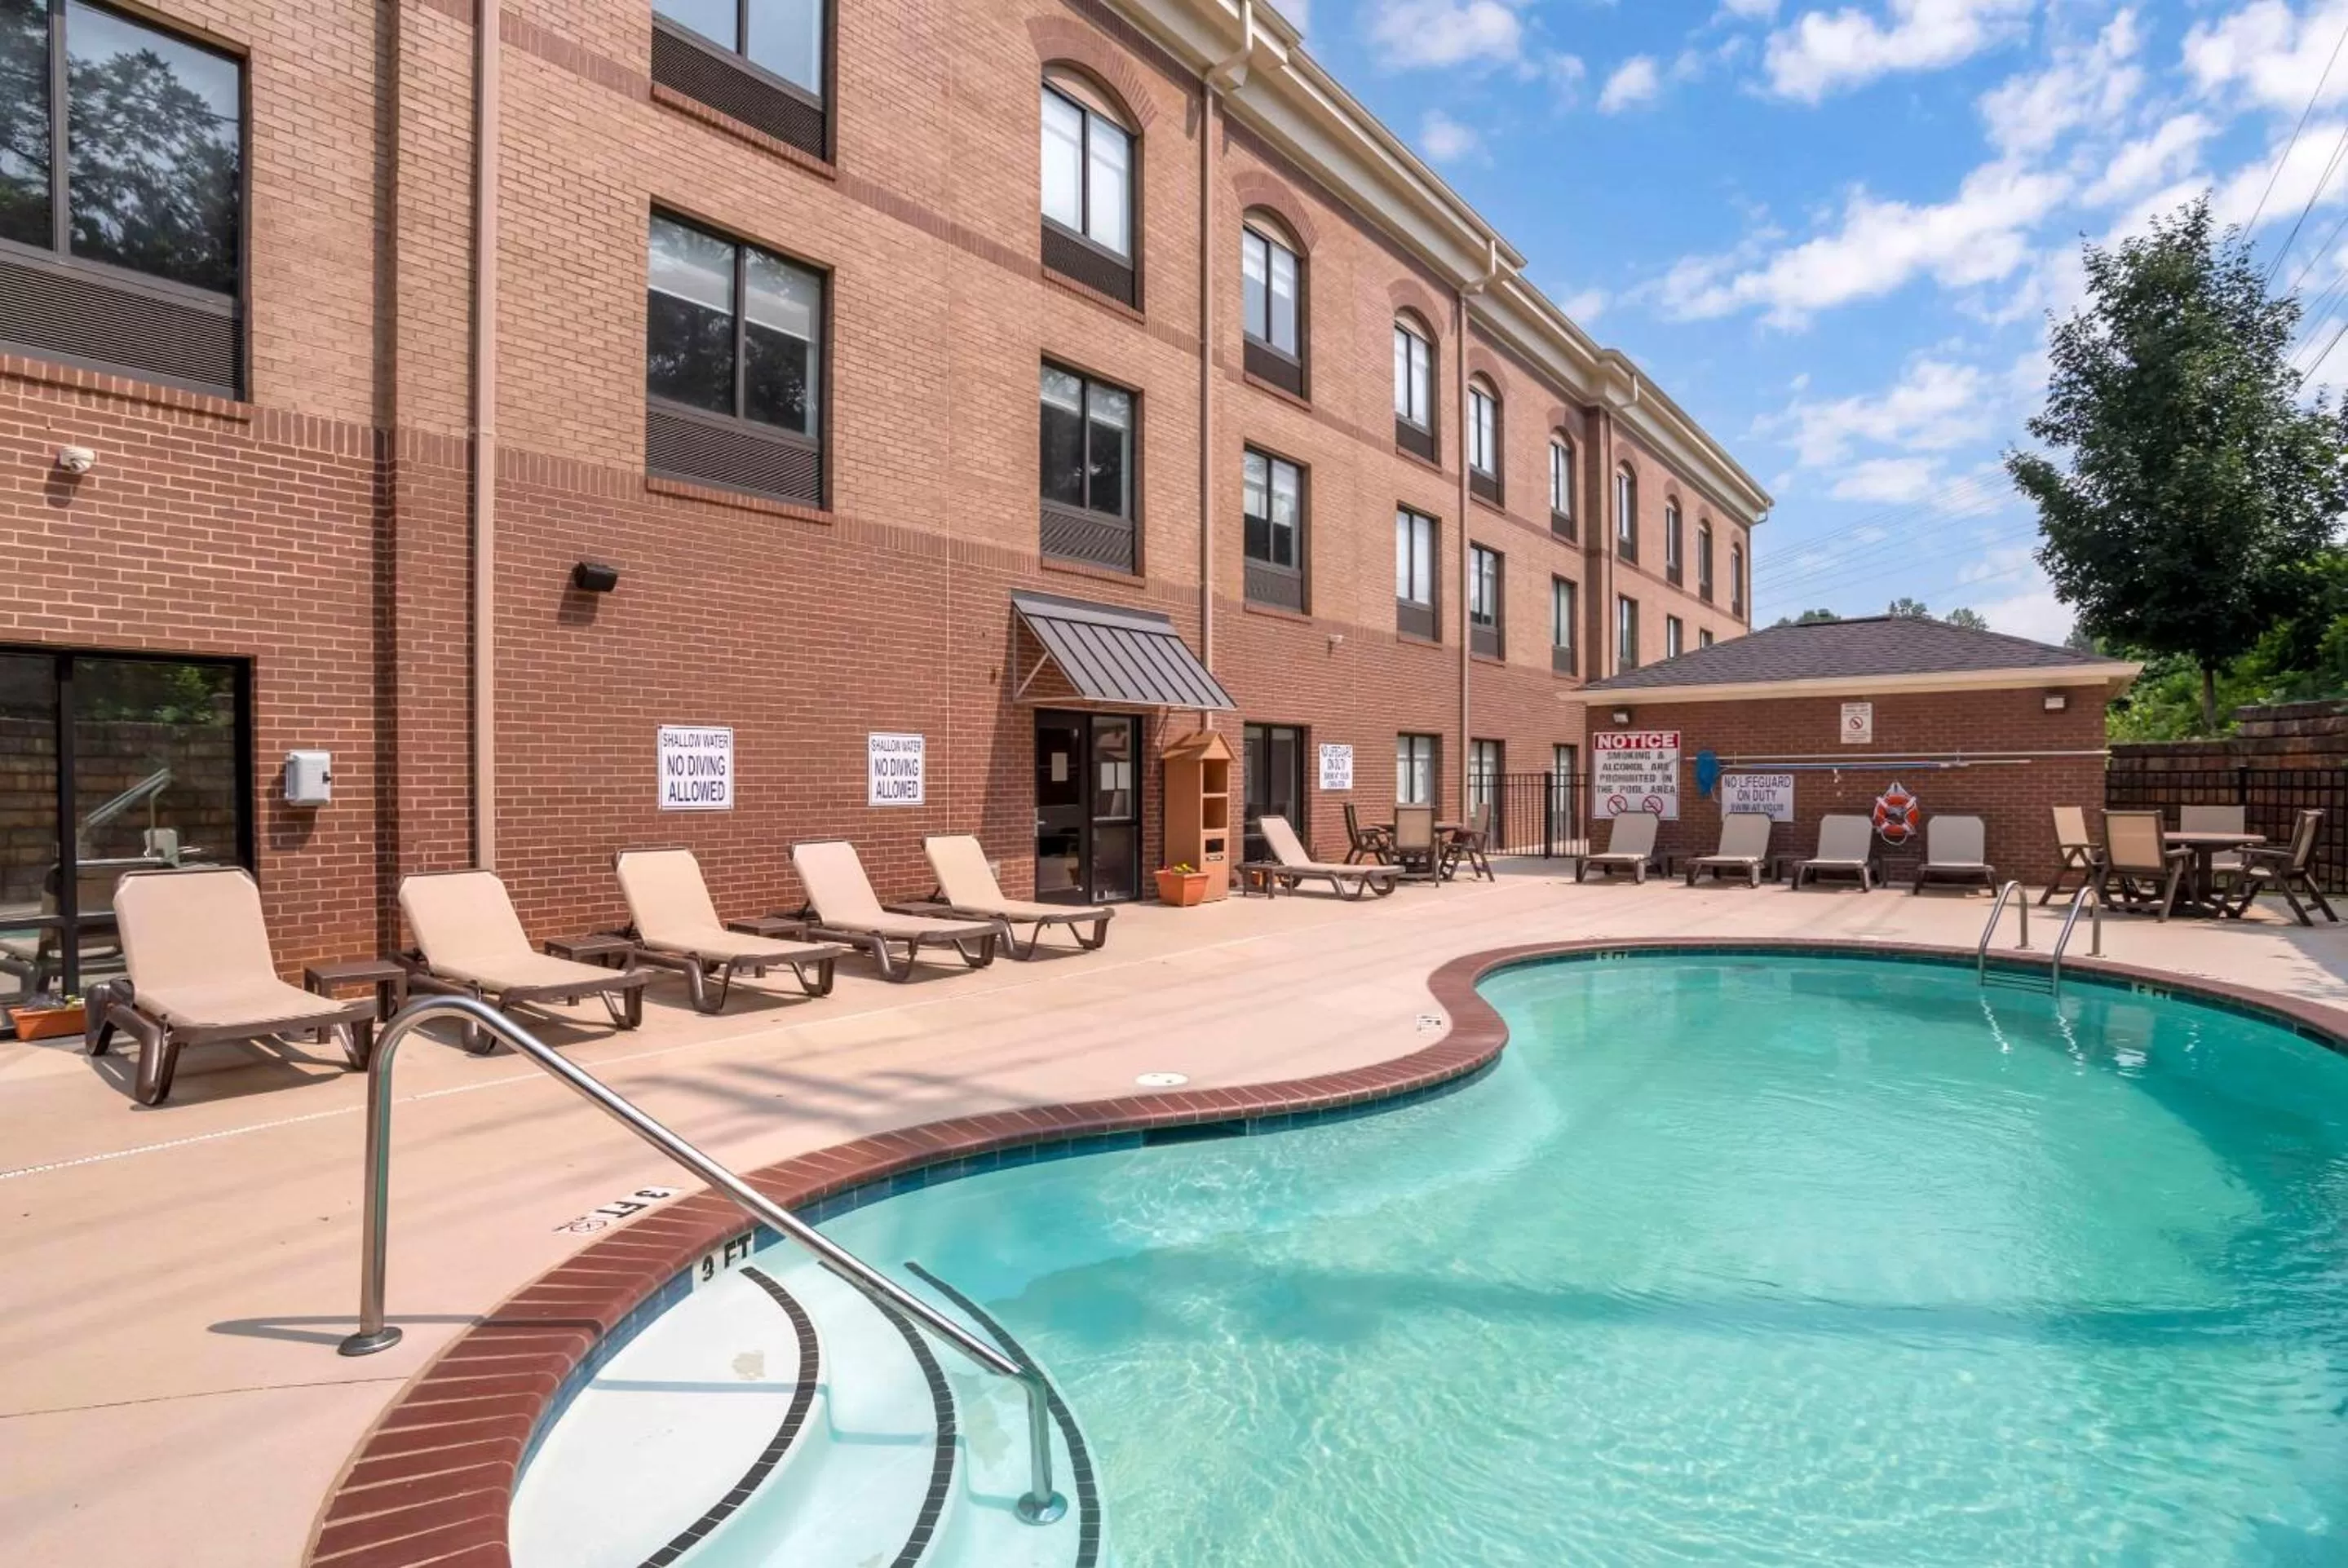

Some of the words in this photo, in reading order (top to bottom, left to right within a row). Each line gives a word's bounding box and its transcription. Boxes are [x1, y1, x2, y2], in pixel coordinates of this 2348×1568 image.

[663, 733, 701, 748] SHALLOW
[703, 733, 728, 749] WATER
[871, 739, 900, 752] SHALLOW
[902, 740, 921, 753] WATER
[1598, 734, 1675, 749] NOTICE
[1607, 751, 1651, 760] SMOKING
[667, 754, 684, 776] NO
[688, 755, 726, 777] DIVING
[874, 757, 888, 776] NO
[890, 757, 918, 776] DIVING
[1603, 762, 1643, 771] ALCOHOL
[1651, 762, 1670, 771] ARE
[1599, 774, 1656, 783] PROHIBITED
[1662, 774, 1672, 783] IN
[1724, 776, 1736, 788] NO
[1739, 775, 1792, 788] LIFEGUARD
[668, 780, 726, 802] ALLOWED
[876, 780, 918, 798] ALLOWED
[1596, 785, 1613, 793] THE
[1619, 785, 1644, 794] POOL
[1650, 785, 1675, 794] AREA
[1736, 789, 1750, 802] ON
[1752, 788, 1778, 802] DUTY
[1751, 804, 1761, 812] AT
[634, 1190, 670, 1199] 3
[595, 1200, 649, 1218] FT
[702, 1254, 714, 1283] 3
[723, 1231, 752, 1269] FT
